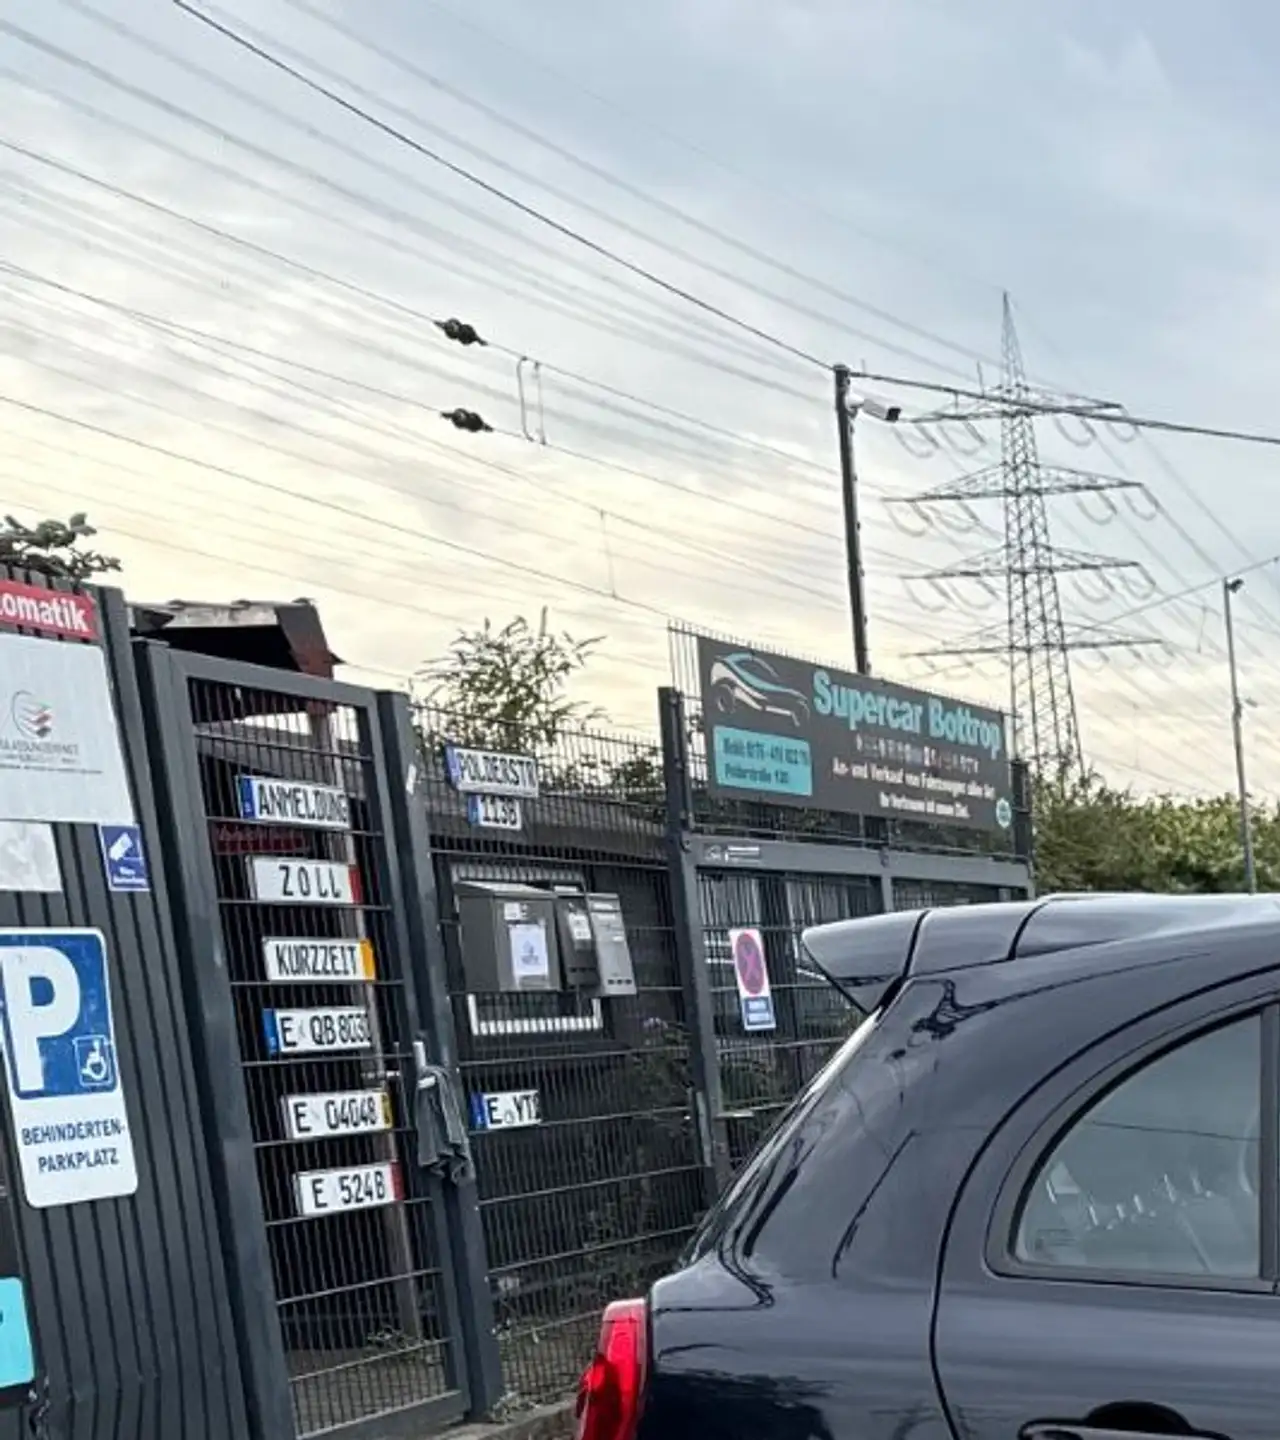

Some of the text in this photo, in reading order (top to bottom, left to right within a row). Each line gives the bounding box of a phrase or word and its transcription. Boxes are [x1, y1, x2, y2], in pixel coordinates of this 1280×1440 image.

[0, 592, 89, 632] omatik
[813, 669, 1000, 759] Supercar Bottrop
[259, 784, 348, 823] ANMELDUNG
[276, 944, 357, 976] KURZZEIT
[0, 946, 80, 1092] P
[279, 1017, 297, 1047] E
[21, 1118, 126, 1146] BEHINDERTEN-
[293, 1102, 311, 1132] E
[38, 1147, 120, 1174] PARKPLATZ
[312, 1178, 328, 1209] E
